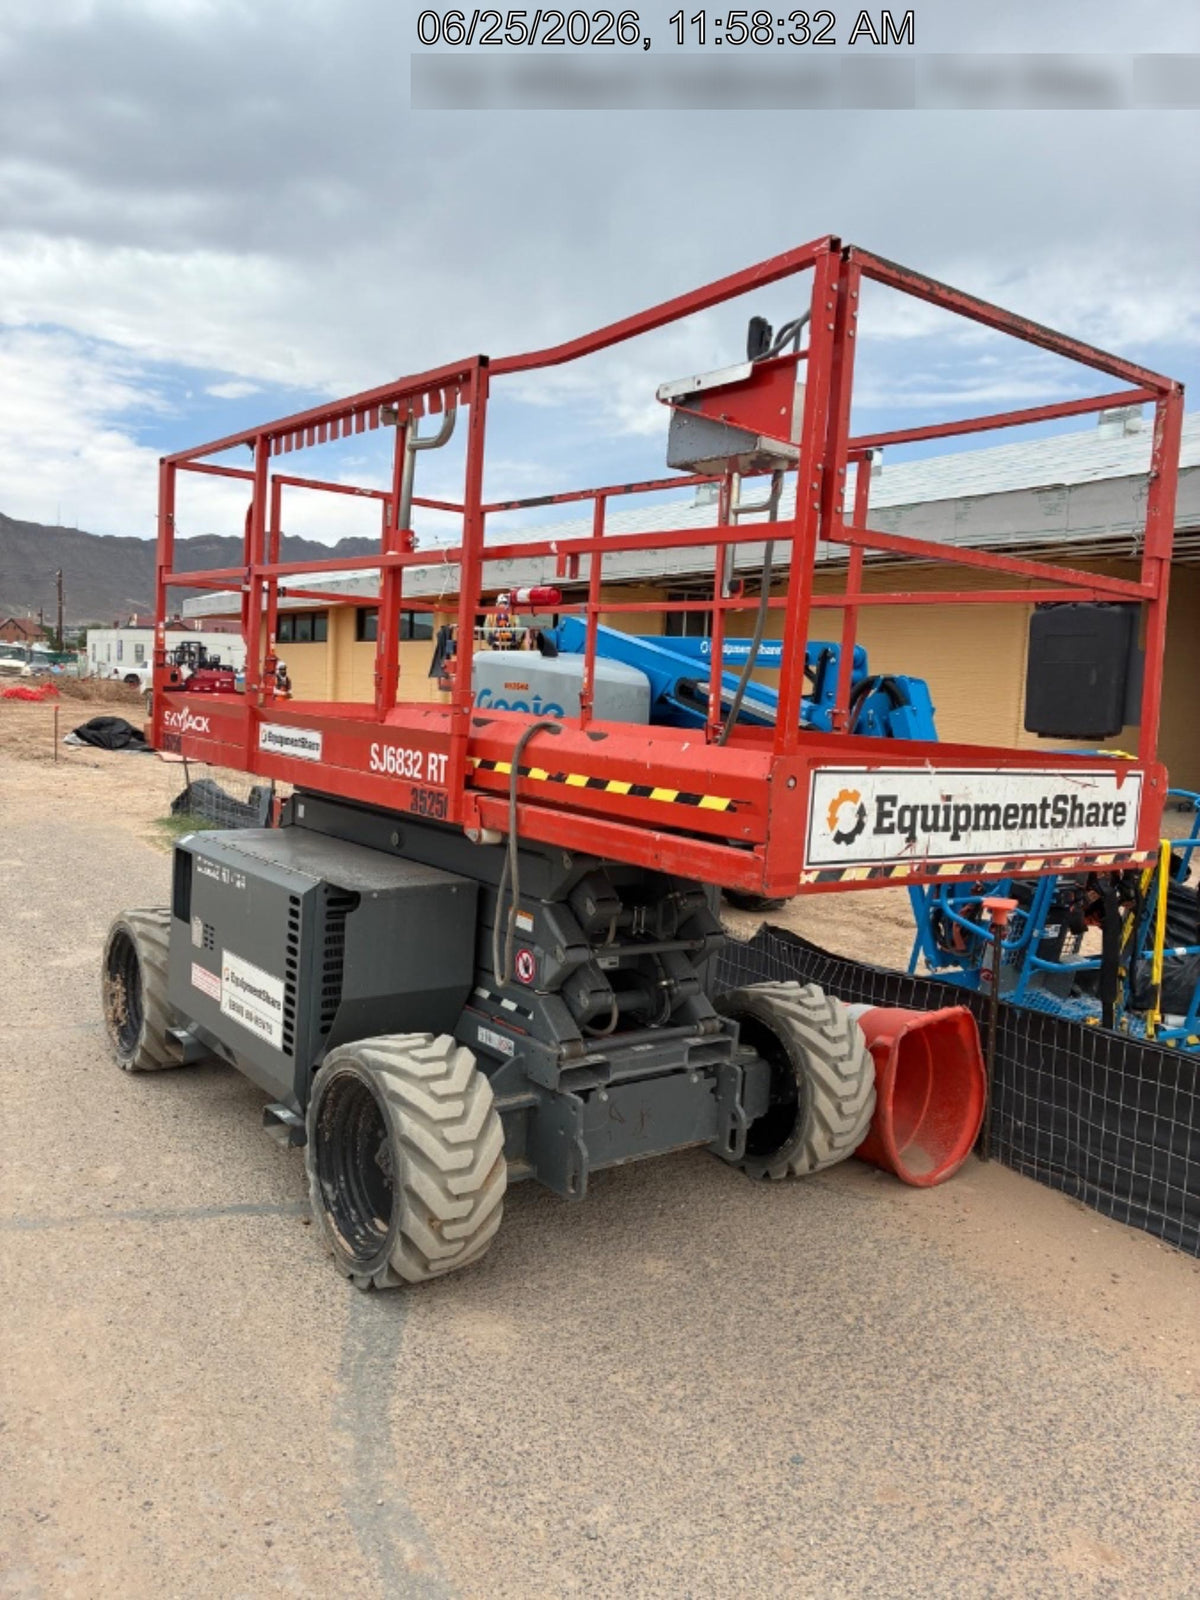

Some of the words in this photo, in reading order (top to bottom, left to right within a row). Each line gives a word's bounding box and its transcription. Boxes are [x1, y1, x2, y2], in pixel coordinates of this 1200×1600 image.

[164, 705, 210, 733] SKYJACK
[369, 742, 423, 780] SJ6832
[427, 752, 449, 783] RT
[873, 794, 1127, 842] EquipmentShare
